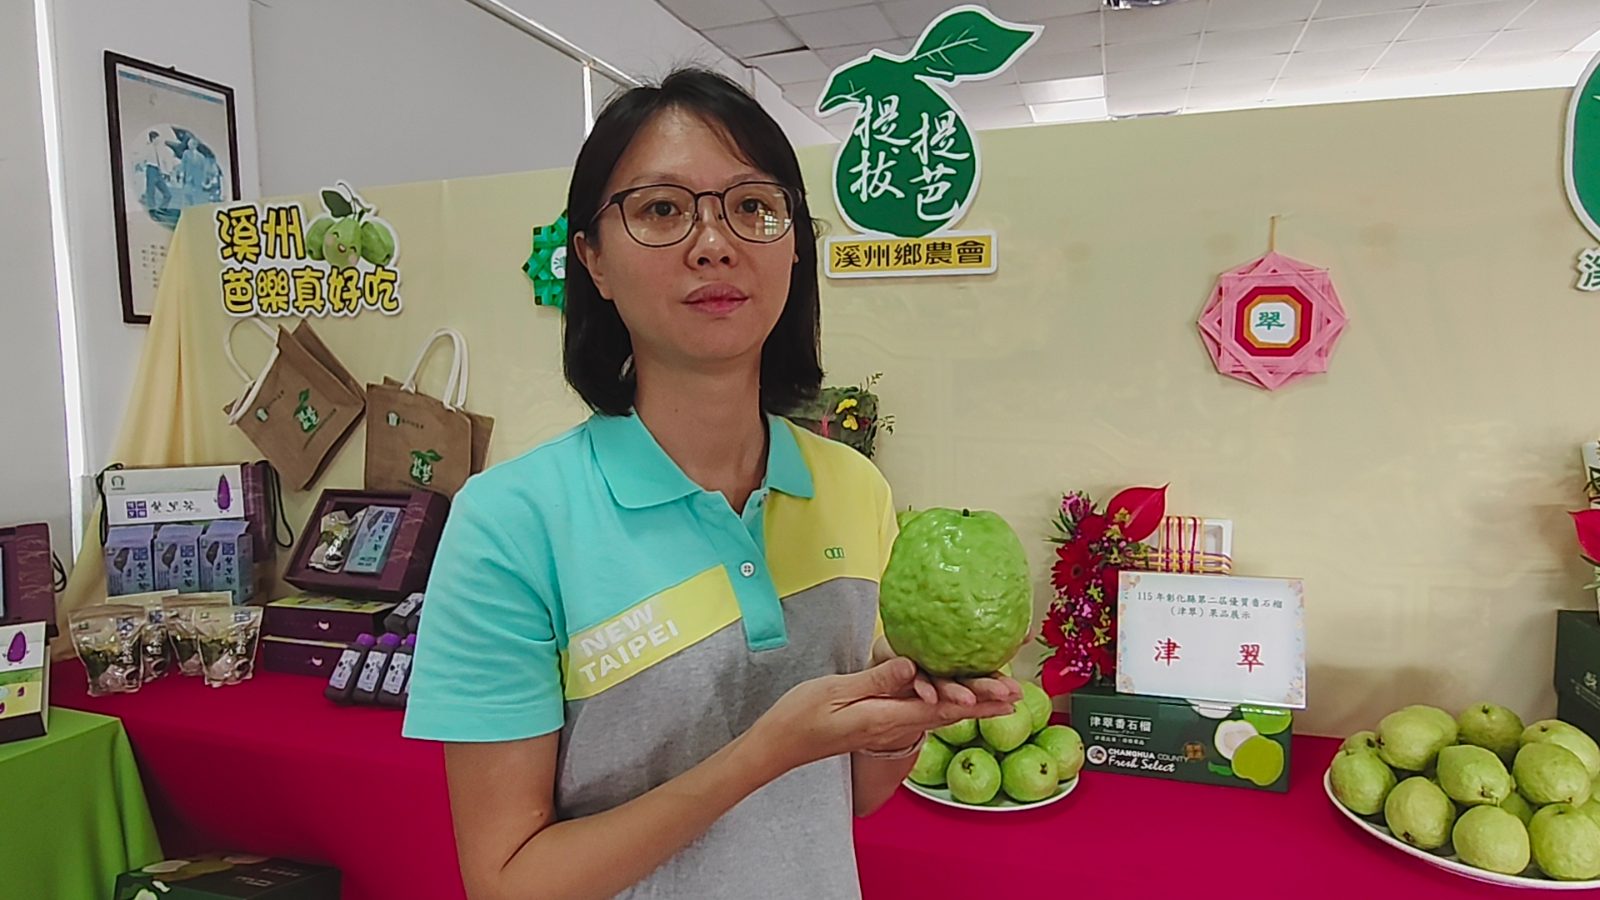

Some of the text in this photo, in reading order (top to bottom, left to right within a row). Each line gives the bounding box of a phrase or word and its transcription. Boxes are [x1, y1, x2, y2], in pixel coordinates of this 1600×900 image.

[217, 205, 306, 264] 溪州
[834, 240, 986, 268] 溪州鄉農會
[222, 265, 401, 313] 芭樂真好吃
[1255, 311, 1286, 330] 翠
[580, 604, 654, 657] NEW
[579, 620, 679, 682] TAIPEI
[1154, 637, 1265, 673] 津 翠
[1108, 747, 1190, 763] CHANGHUA COUNTY
[1108, 755, 1176, 773] Fresh Select
